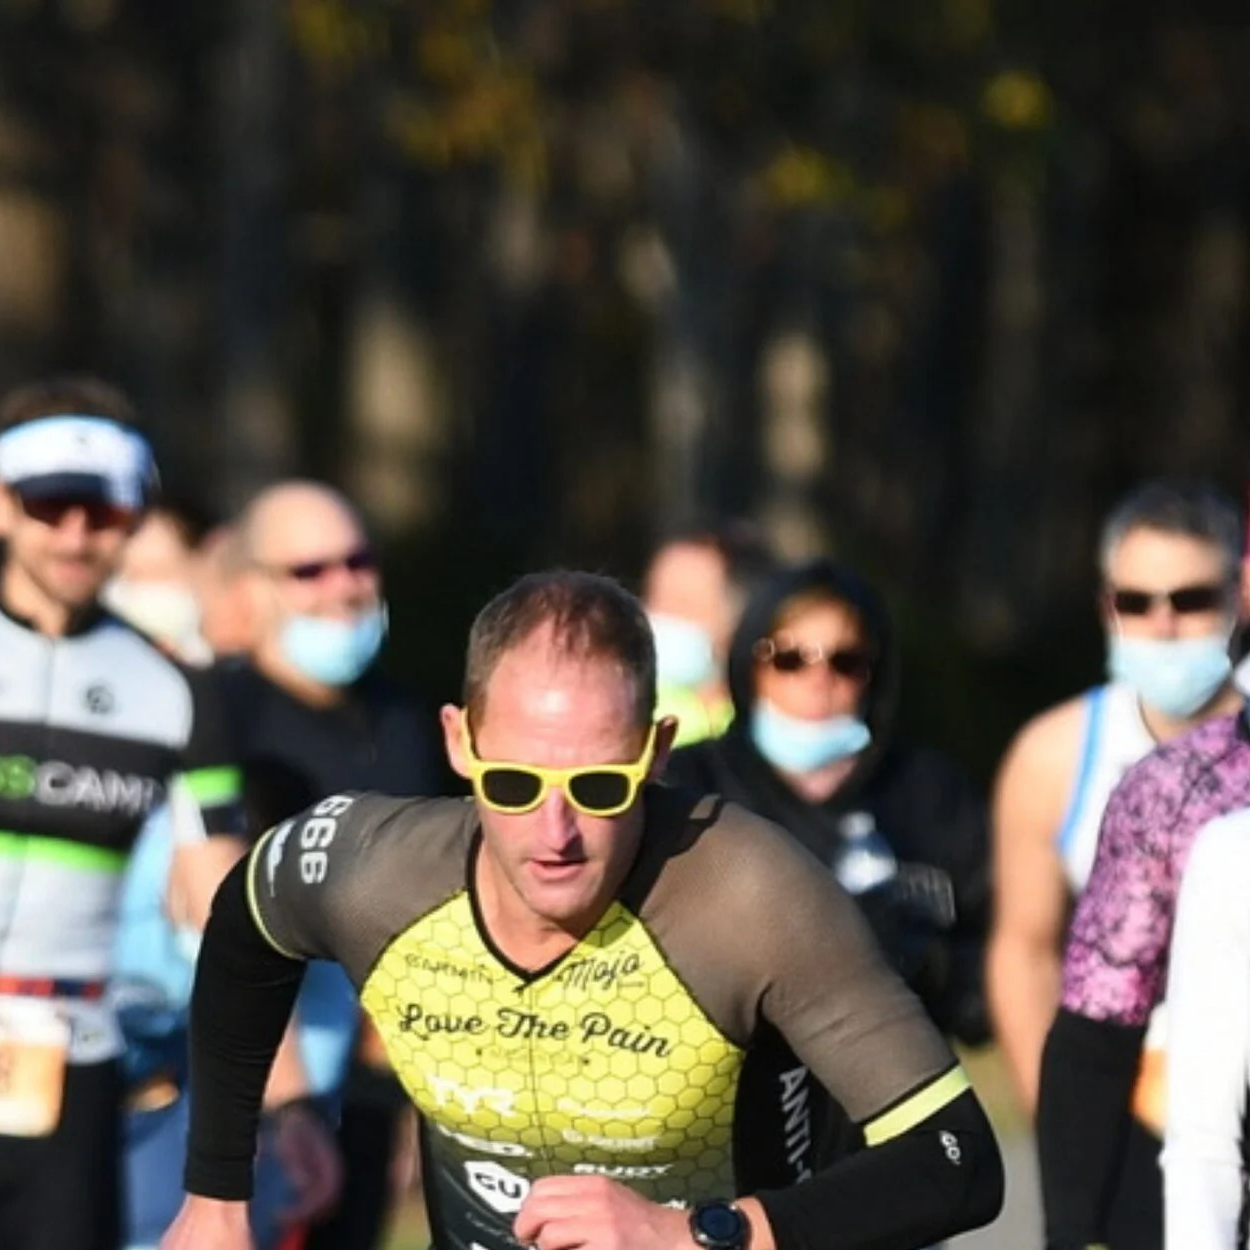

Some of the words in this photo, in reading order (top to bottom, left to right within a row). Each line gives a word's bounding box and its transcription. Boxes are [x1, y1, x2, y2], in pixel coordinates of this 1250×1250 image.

[555, 951, 642, 991] Mojo
[400, 1003, 486, 1041] Love
[496, 1006, 571, 1040] The
[580, 1011, 671, 1057] Pain
